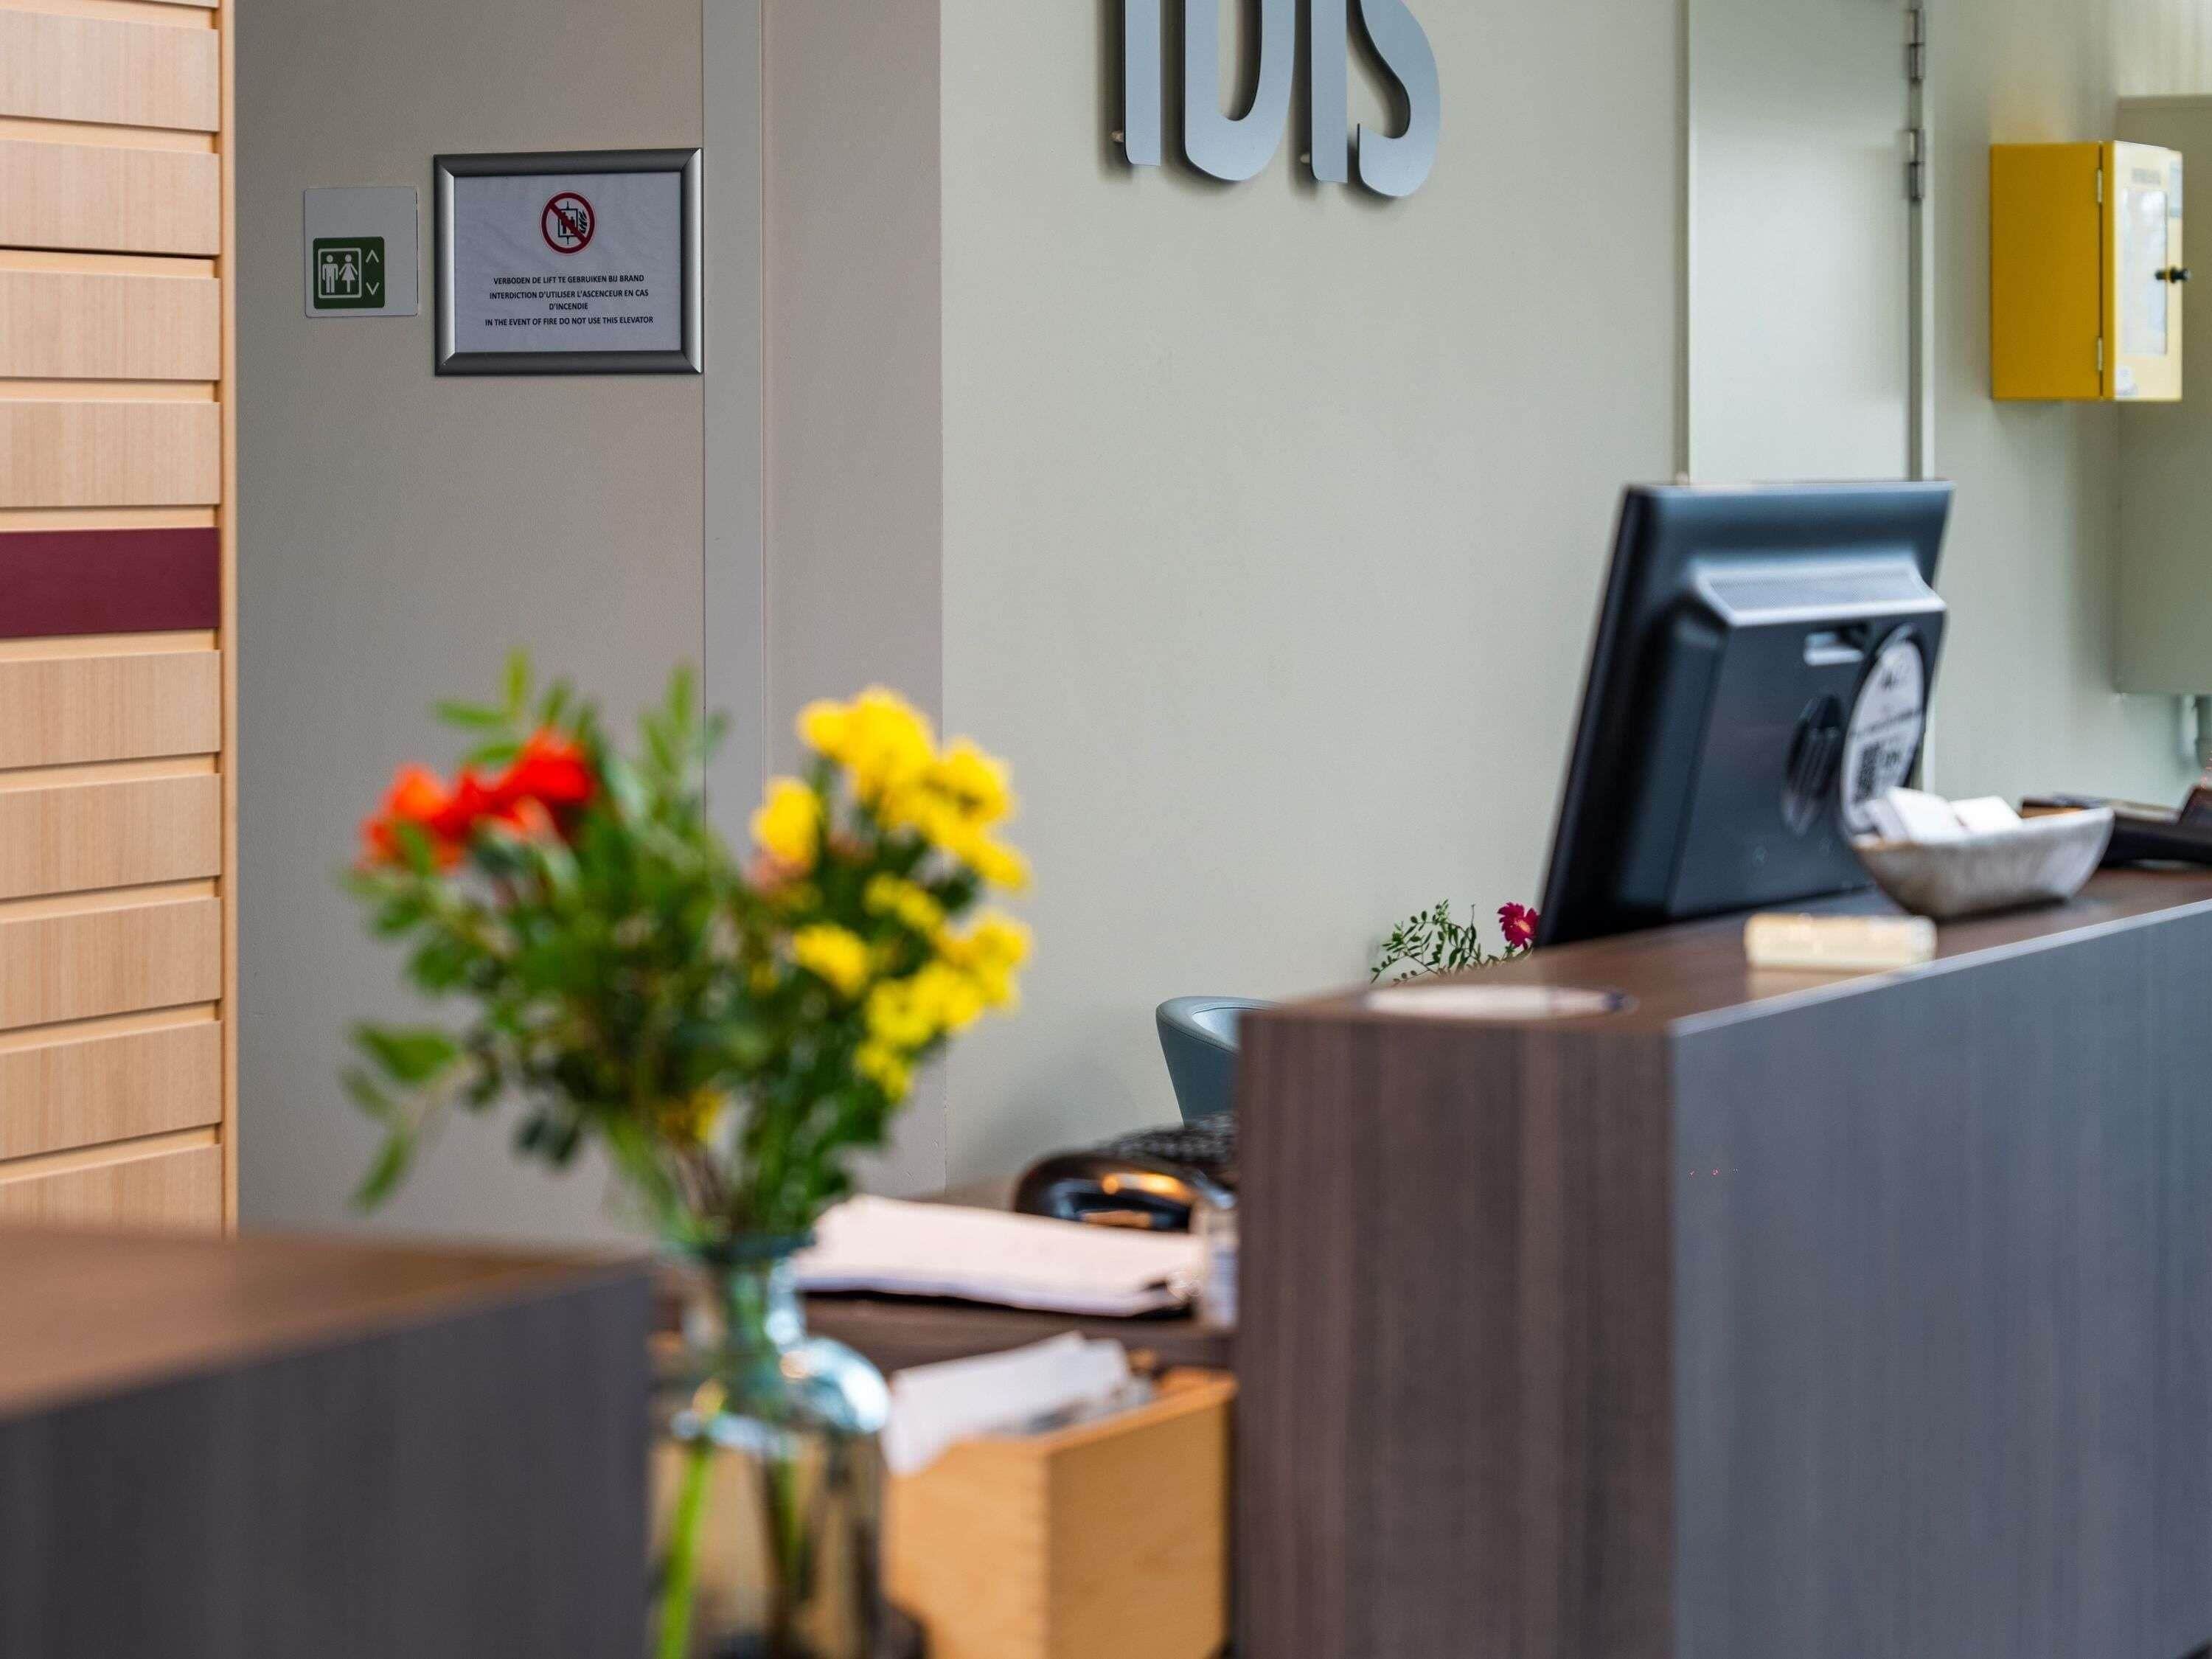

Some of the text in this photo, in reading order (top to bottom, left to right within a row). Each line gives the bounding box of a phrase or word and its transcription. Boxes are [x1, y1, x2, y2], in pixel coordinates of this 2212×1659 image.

[493, 276, 530, 285] VERBODEN
[568, 275, 607, 283] GEBRUIKEN
[490, 291, 538, 299] INTERDICTION
[539, 291, 575, 299] D'UTILISER
[549, 302, 588, 310] D'INCENDIE
[509, 318, 531, 326] EVENT
[619, 316, 654, 324] ELEVATOR
